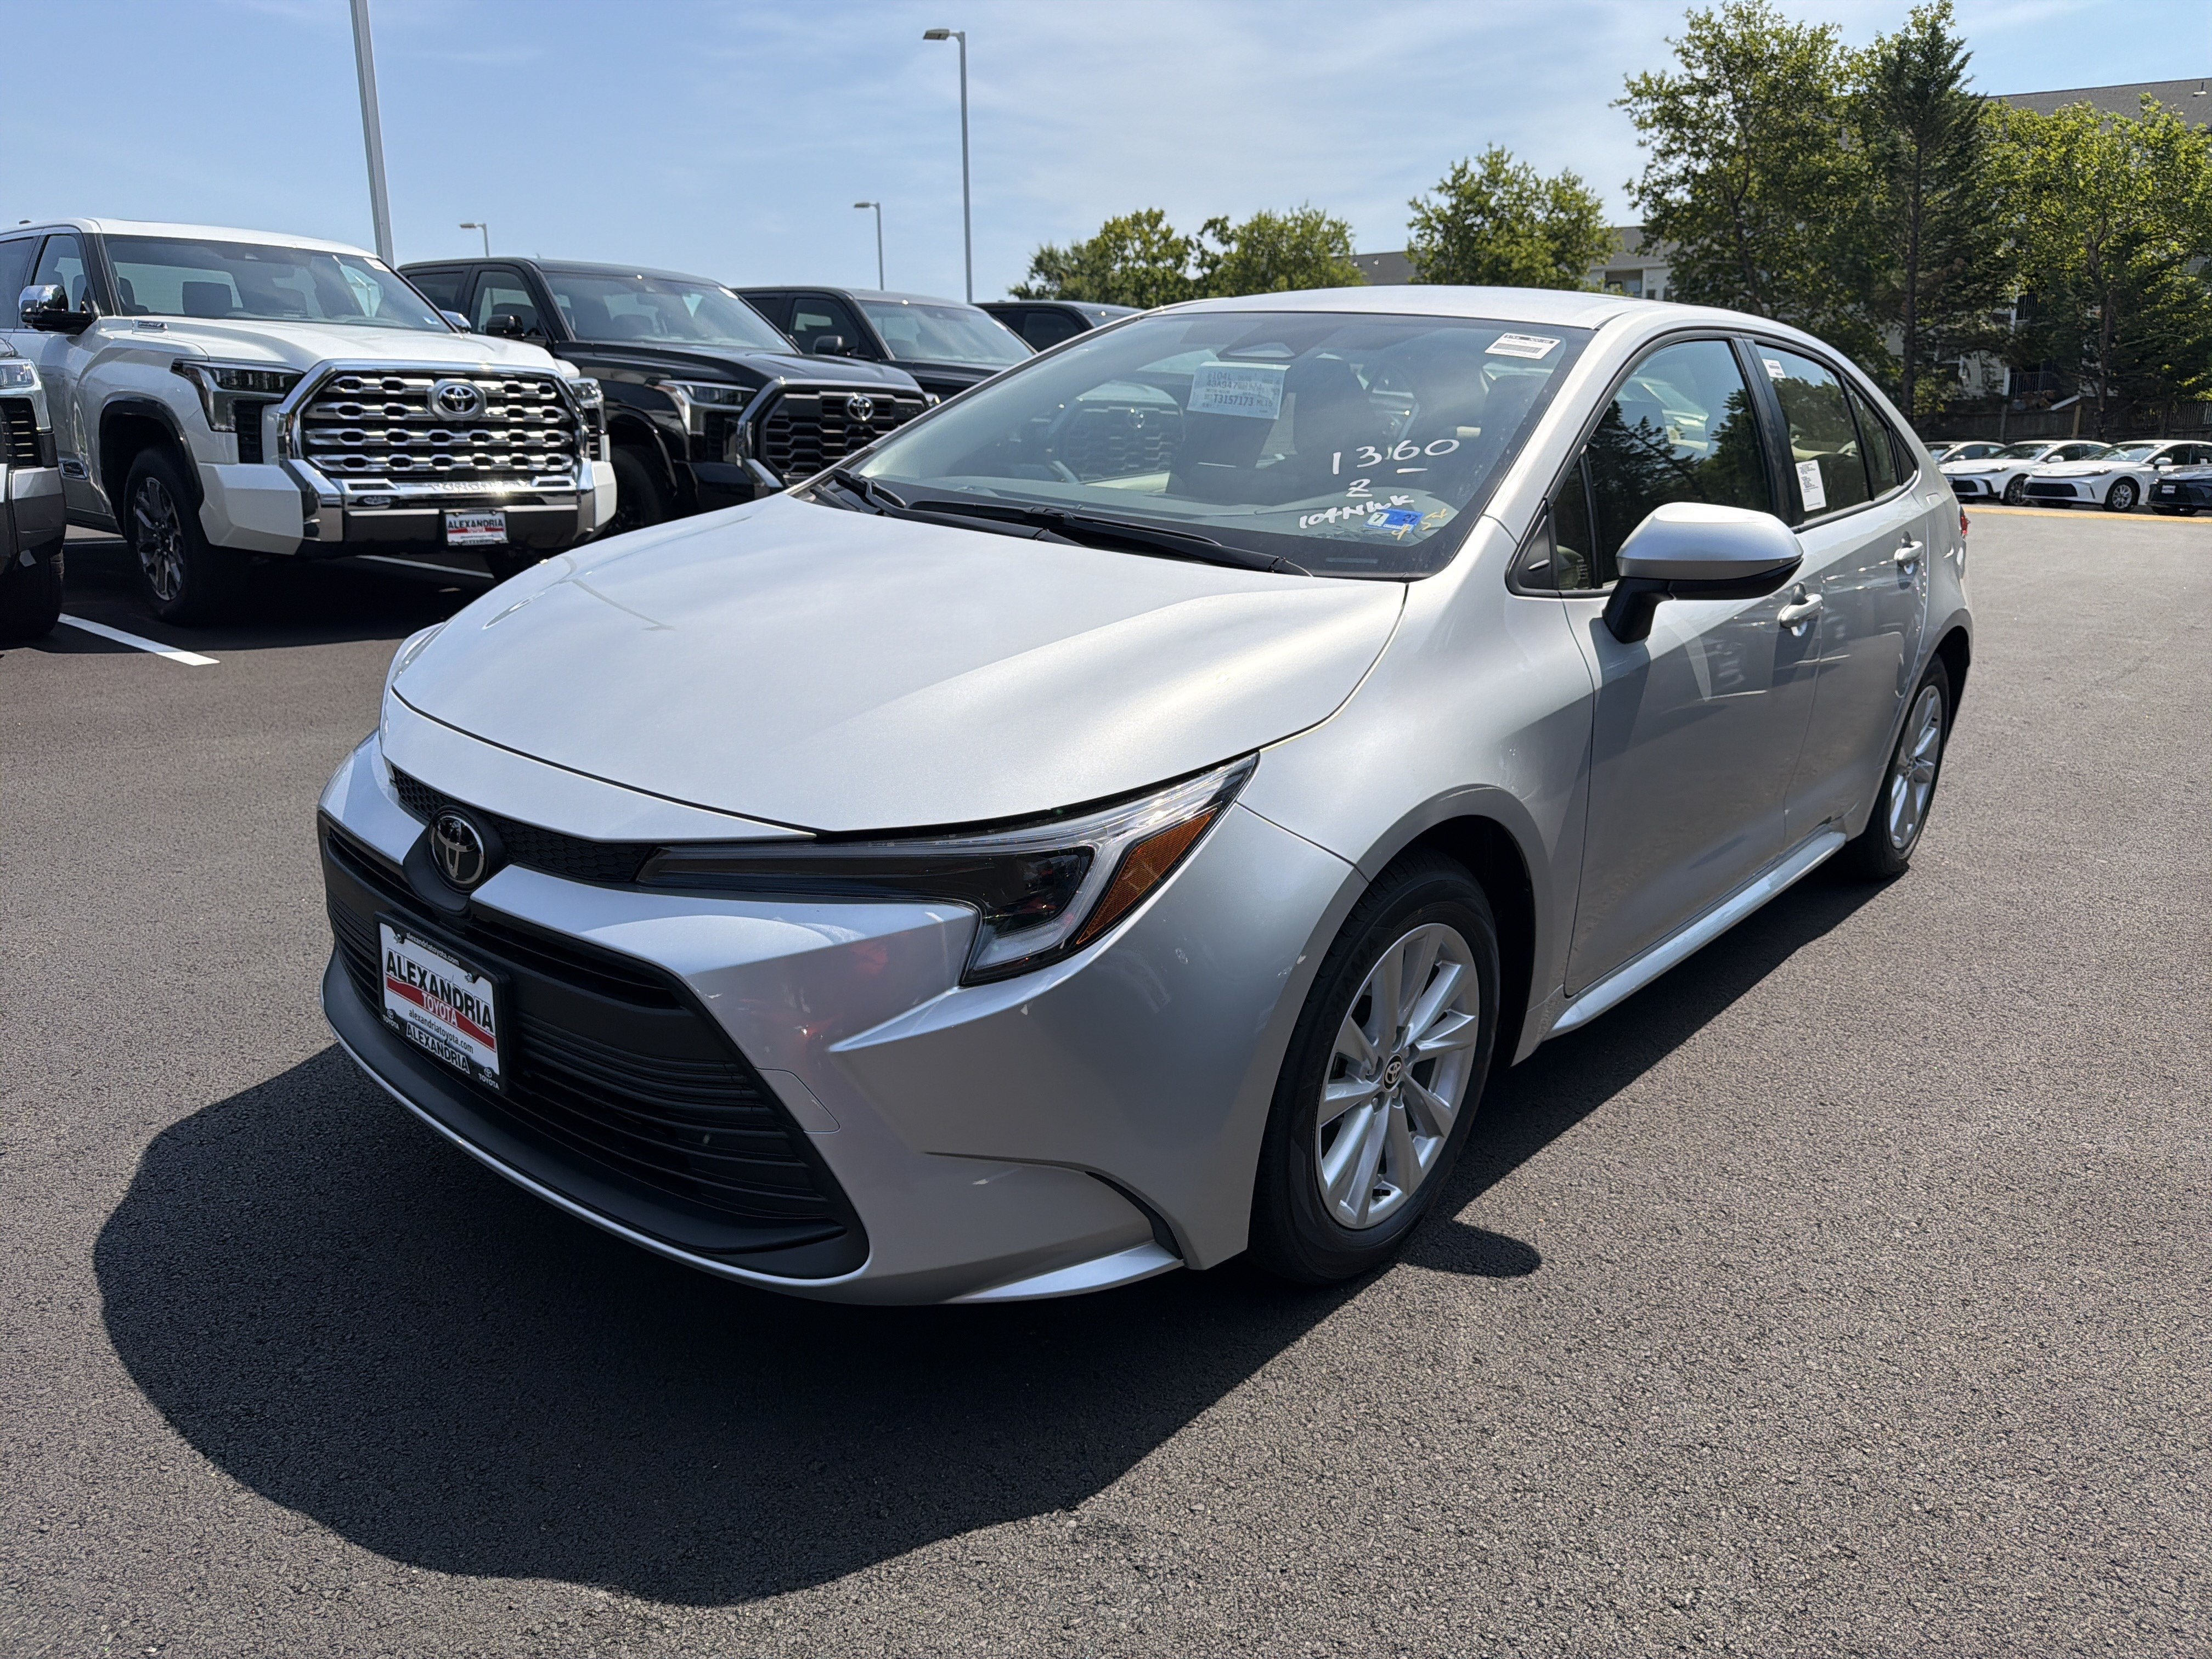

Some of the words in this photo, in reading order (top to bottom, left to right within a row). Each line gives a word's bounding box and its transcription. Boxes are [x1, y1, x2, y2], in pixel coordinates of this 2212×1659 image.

[1332, 439, 1460, 475] 1360
[448, 519, 504, 528] ALEXANDRIA
[386, 950, 494, 1034] ALEXANDRIA
[421, 991, 459, 1028] TOYOTA
[382, 1014, 400, 1031] TOYOTA
[408, 1009, 474, 1054] alexandriatoyota.com
[405, 1021, 471, 1075] ALEXANDRIA
[478, 1072, 500, 1091] TOYOTA
